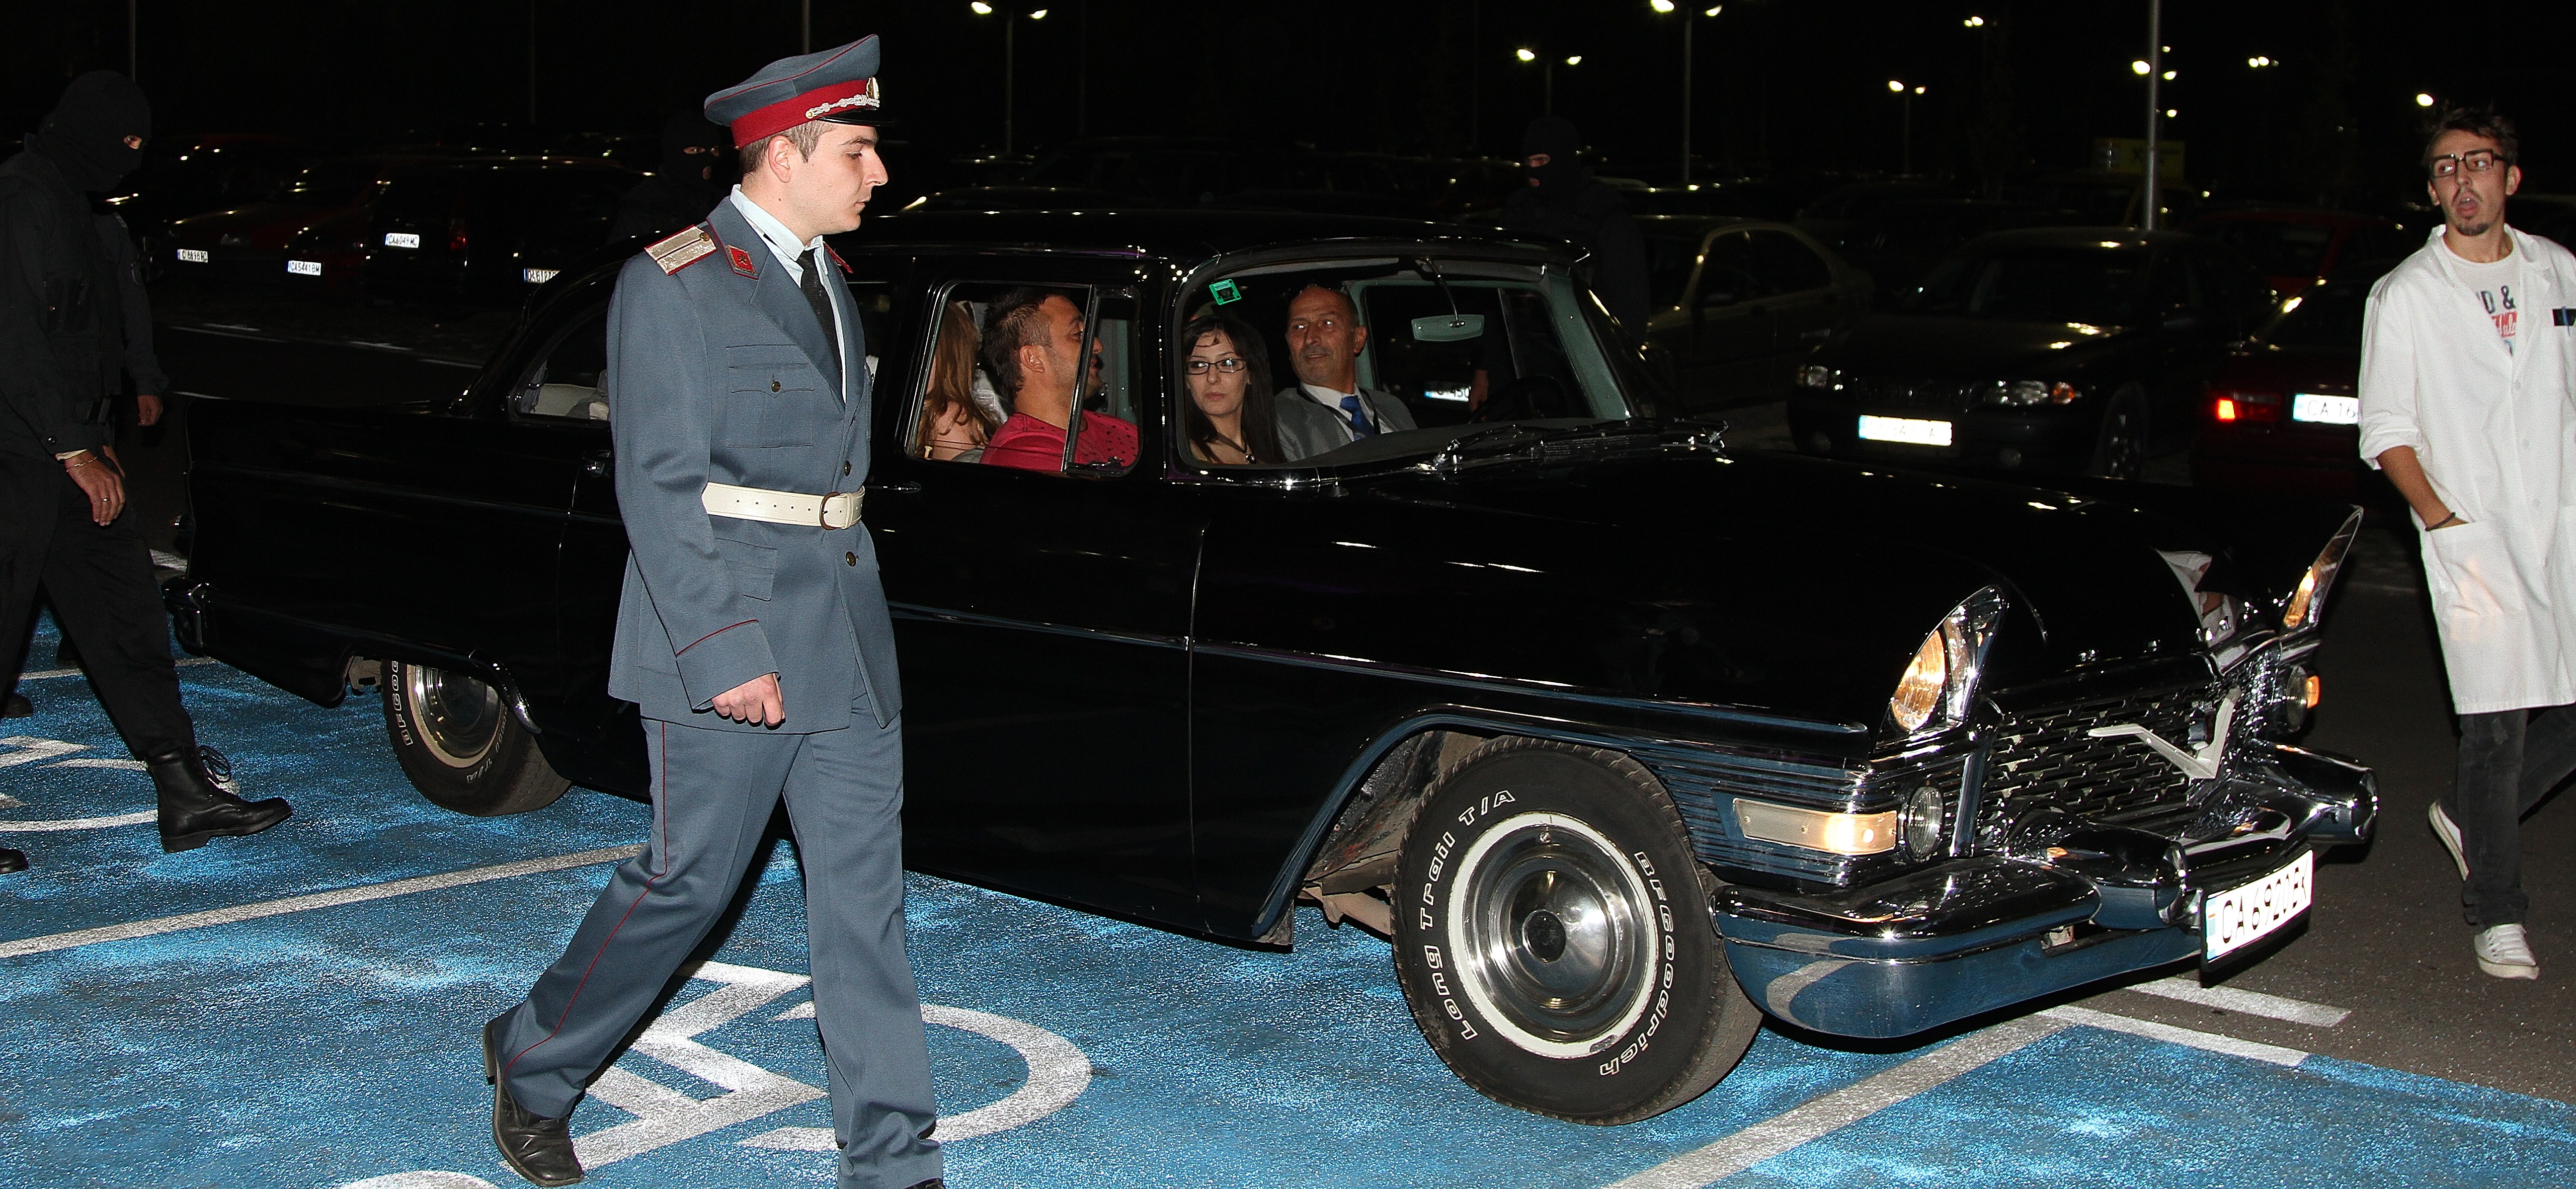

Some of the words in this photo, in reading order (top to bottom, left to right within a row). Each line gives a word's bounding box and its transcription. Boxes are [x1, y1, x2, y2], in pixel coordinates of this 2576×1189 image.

[2501, 285, 2516, 309] &
[1458, 790, 1516, 826] T/A
[1420, 831, 1456, 930] Trail
[1424, 945, 1478, 1040] Long
